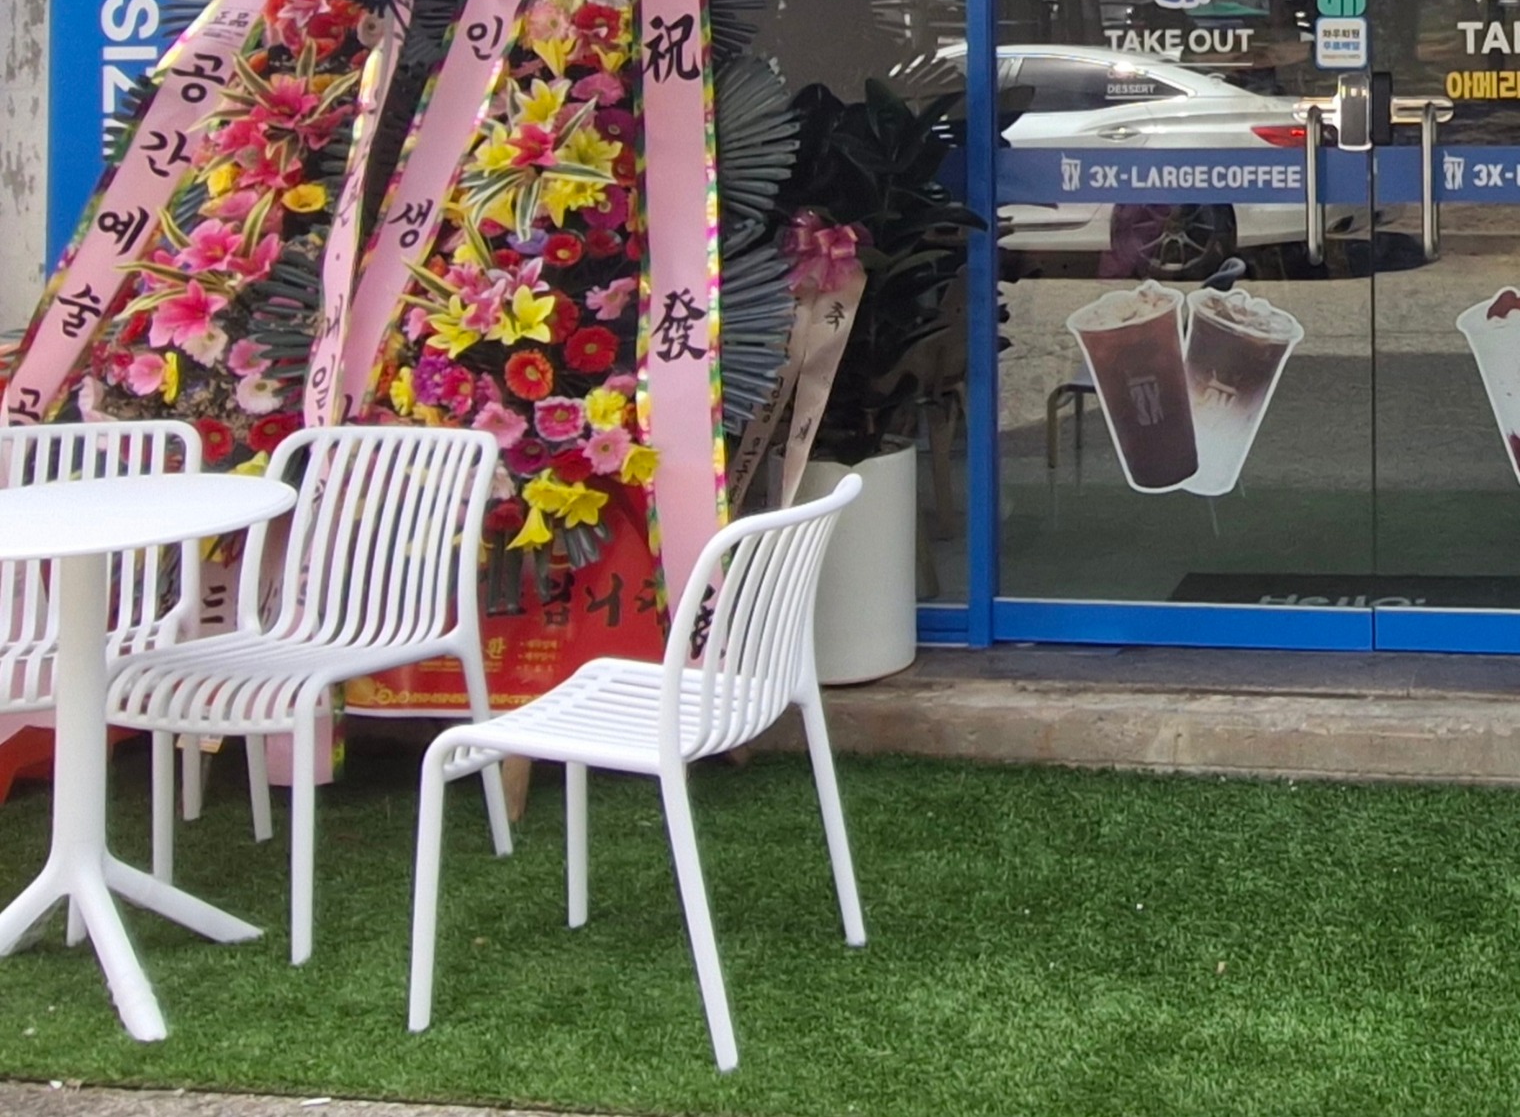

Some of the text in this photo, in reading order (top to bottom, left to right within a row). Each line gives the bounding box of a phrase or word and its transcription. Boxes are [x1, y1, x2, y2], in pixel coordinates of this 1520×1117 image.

[1104, 29, 1255, 54] TAKE OUT
[1089, 166, 1209, 189] 3X-LARGE
[1211, 165, 1302, 189] COFFEE
